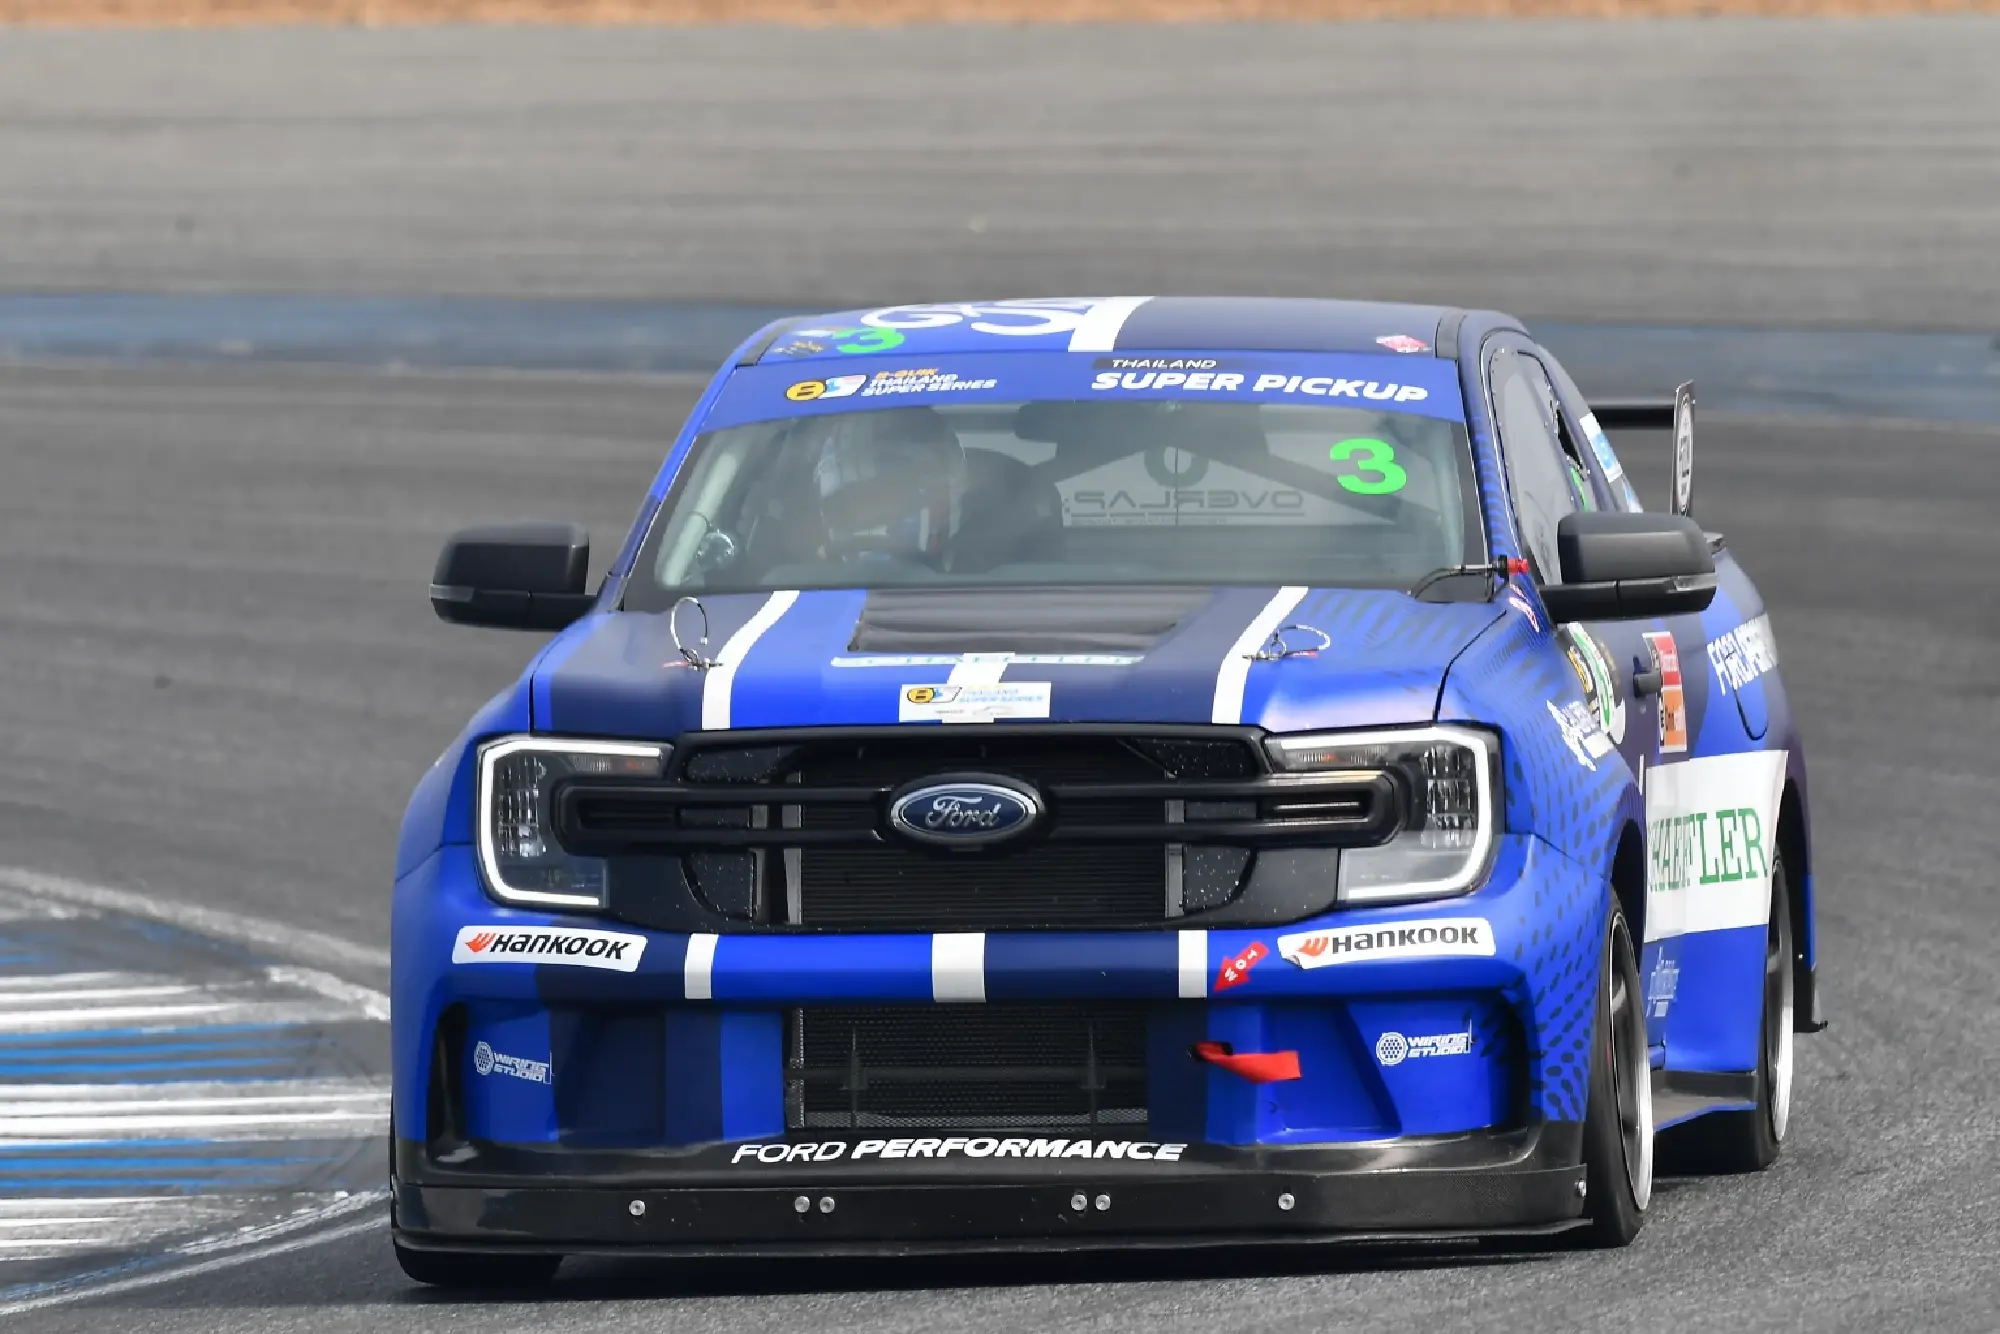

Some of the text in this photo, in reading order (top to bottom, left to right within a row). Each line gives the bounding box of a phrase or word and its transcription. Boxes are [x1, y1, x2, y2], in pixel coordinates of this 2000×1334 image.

[832, 327, 905, 353] 3
[1112, 359, 1217, 369] THAILAND
[1091, 372, 1429, 402] SUPER PICKUP
[1329, 438, 1407, 495] 3
[925, 796, 1002, 827] Ford
[731, 1136, 1189, 1163] FORD PERFORMANCE
